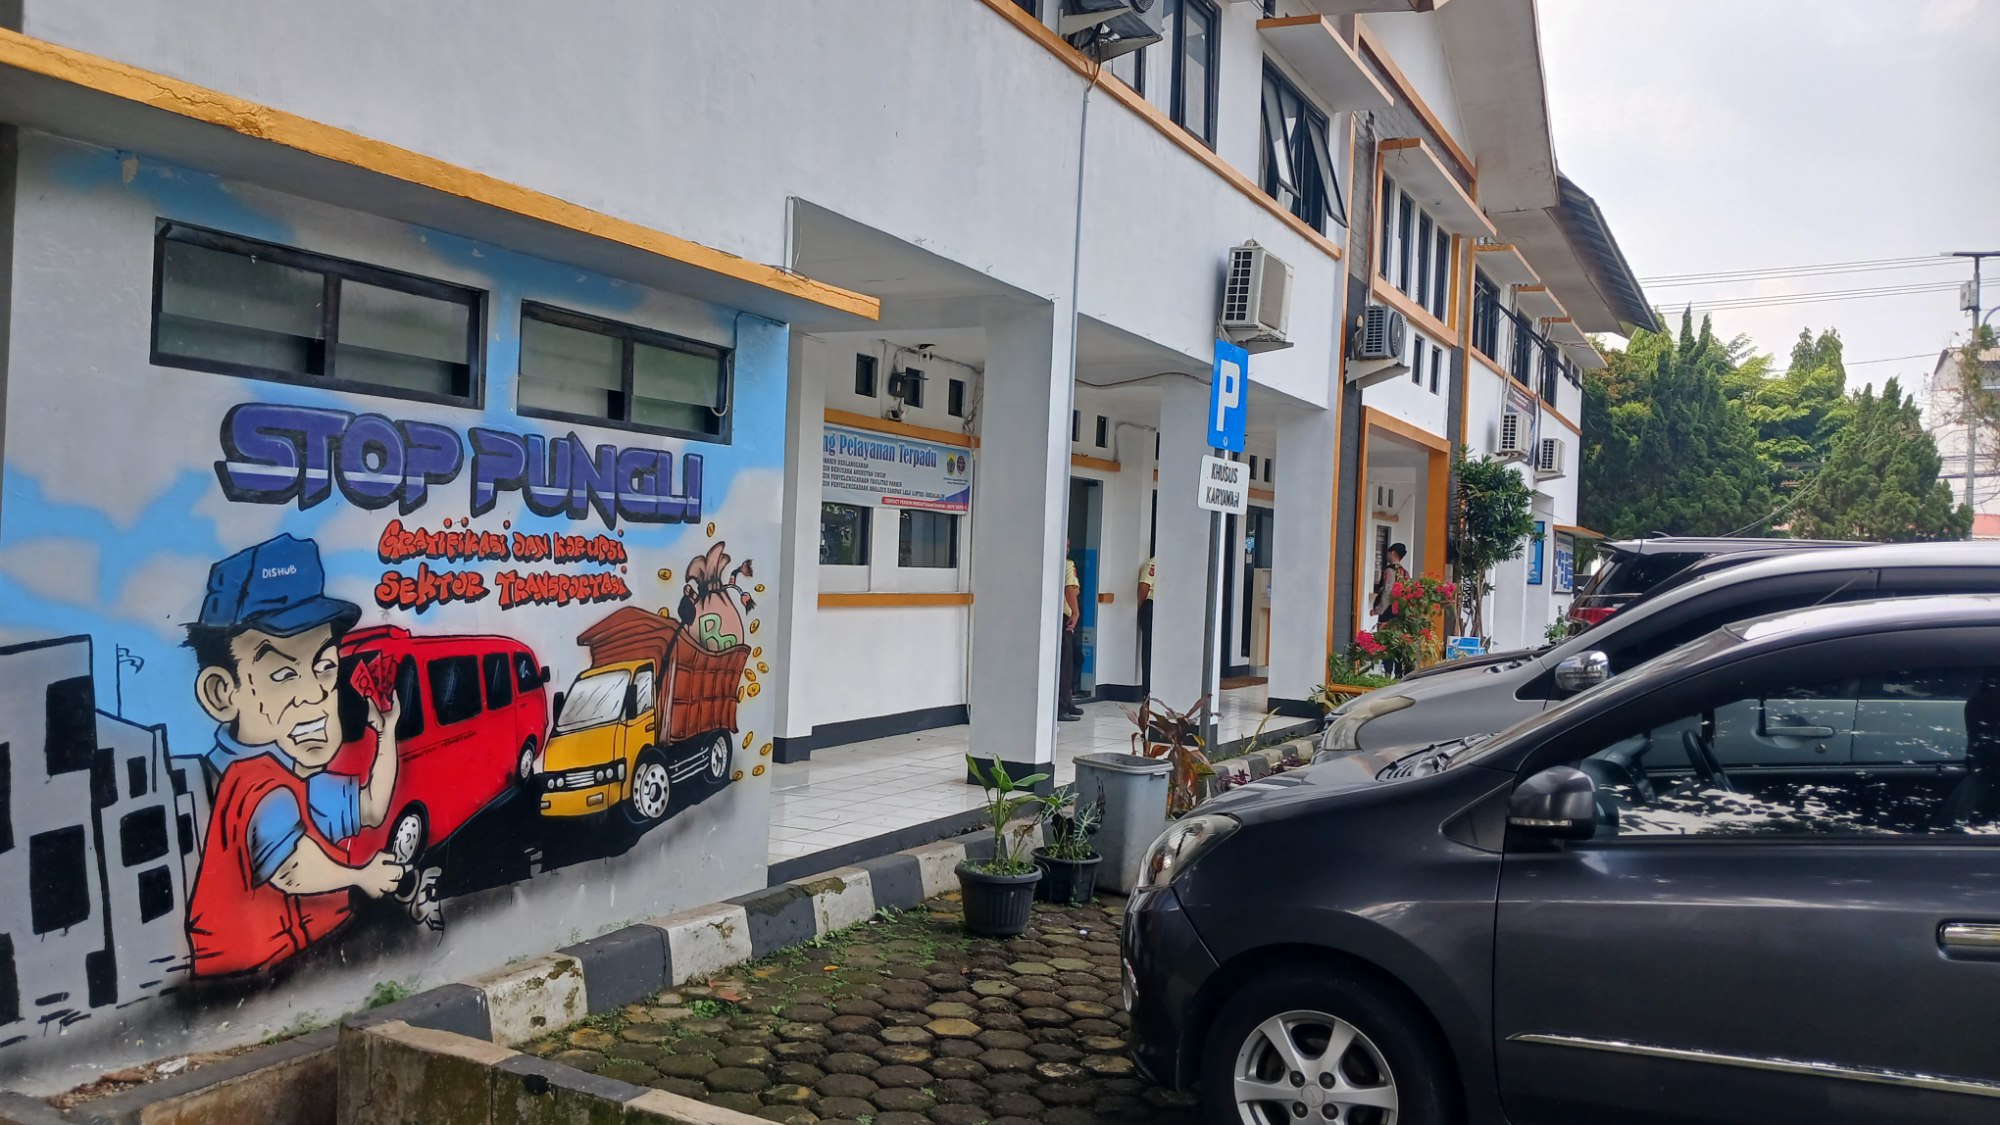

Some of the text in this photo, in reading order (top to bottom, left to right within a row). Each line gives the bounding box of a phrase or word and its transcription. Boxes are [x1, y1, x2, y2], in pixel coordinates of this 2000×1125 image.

[1216, 359, 1240, 433] P
[838, 433, 896, 462] Pelayanan
[898, 444, 937, 468] Terpadu
[214, 402, 703, 530] STOP PUNGLI
[1211, 462, 1239, 485] KHUSUS
[1206, 486, 1240, 509] KARYAWAN
[262, 564, 297, 579] DISHUB
